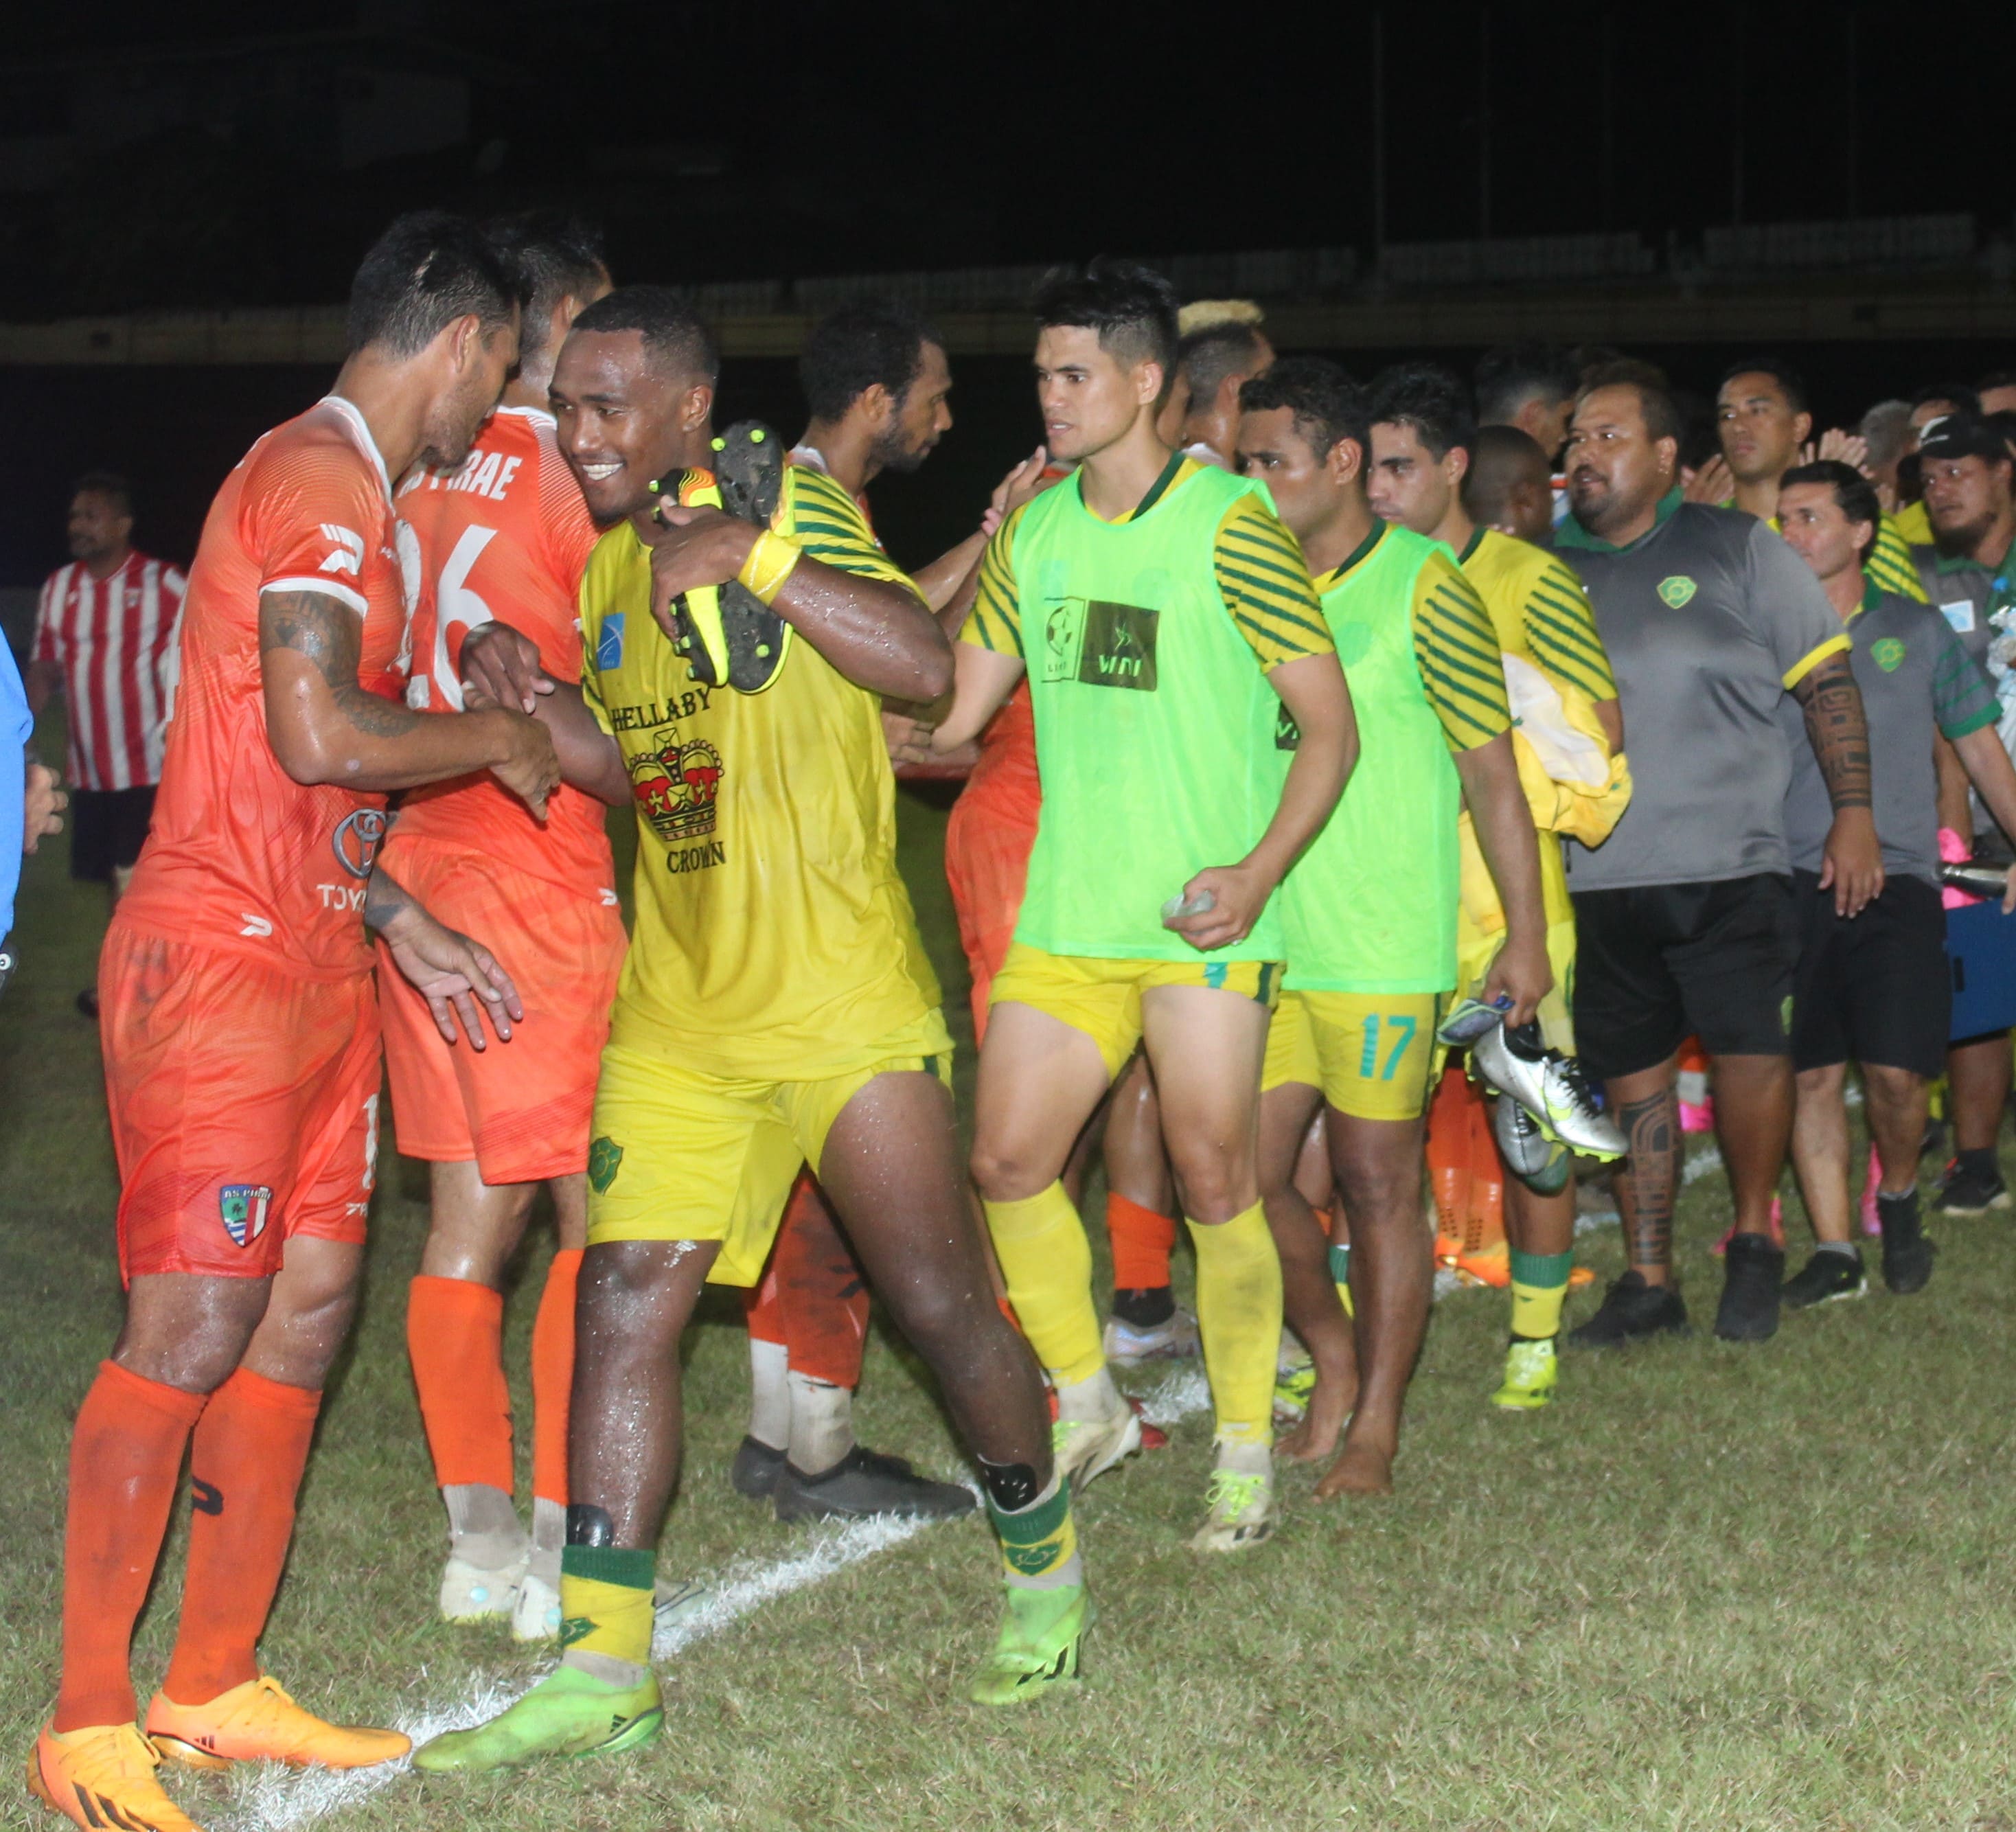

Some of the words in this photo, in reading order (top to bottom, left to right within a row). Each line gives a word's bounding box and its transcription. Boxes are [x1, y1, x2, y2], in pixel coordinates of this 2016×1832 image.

[610, 686, 711, 732] HELLABY
[667, 840, 726, 874] CROWN
[1360, 1012, 1417, 1081] 17
